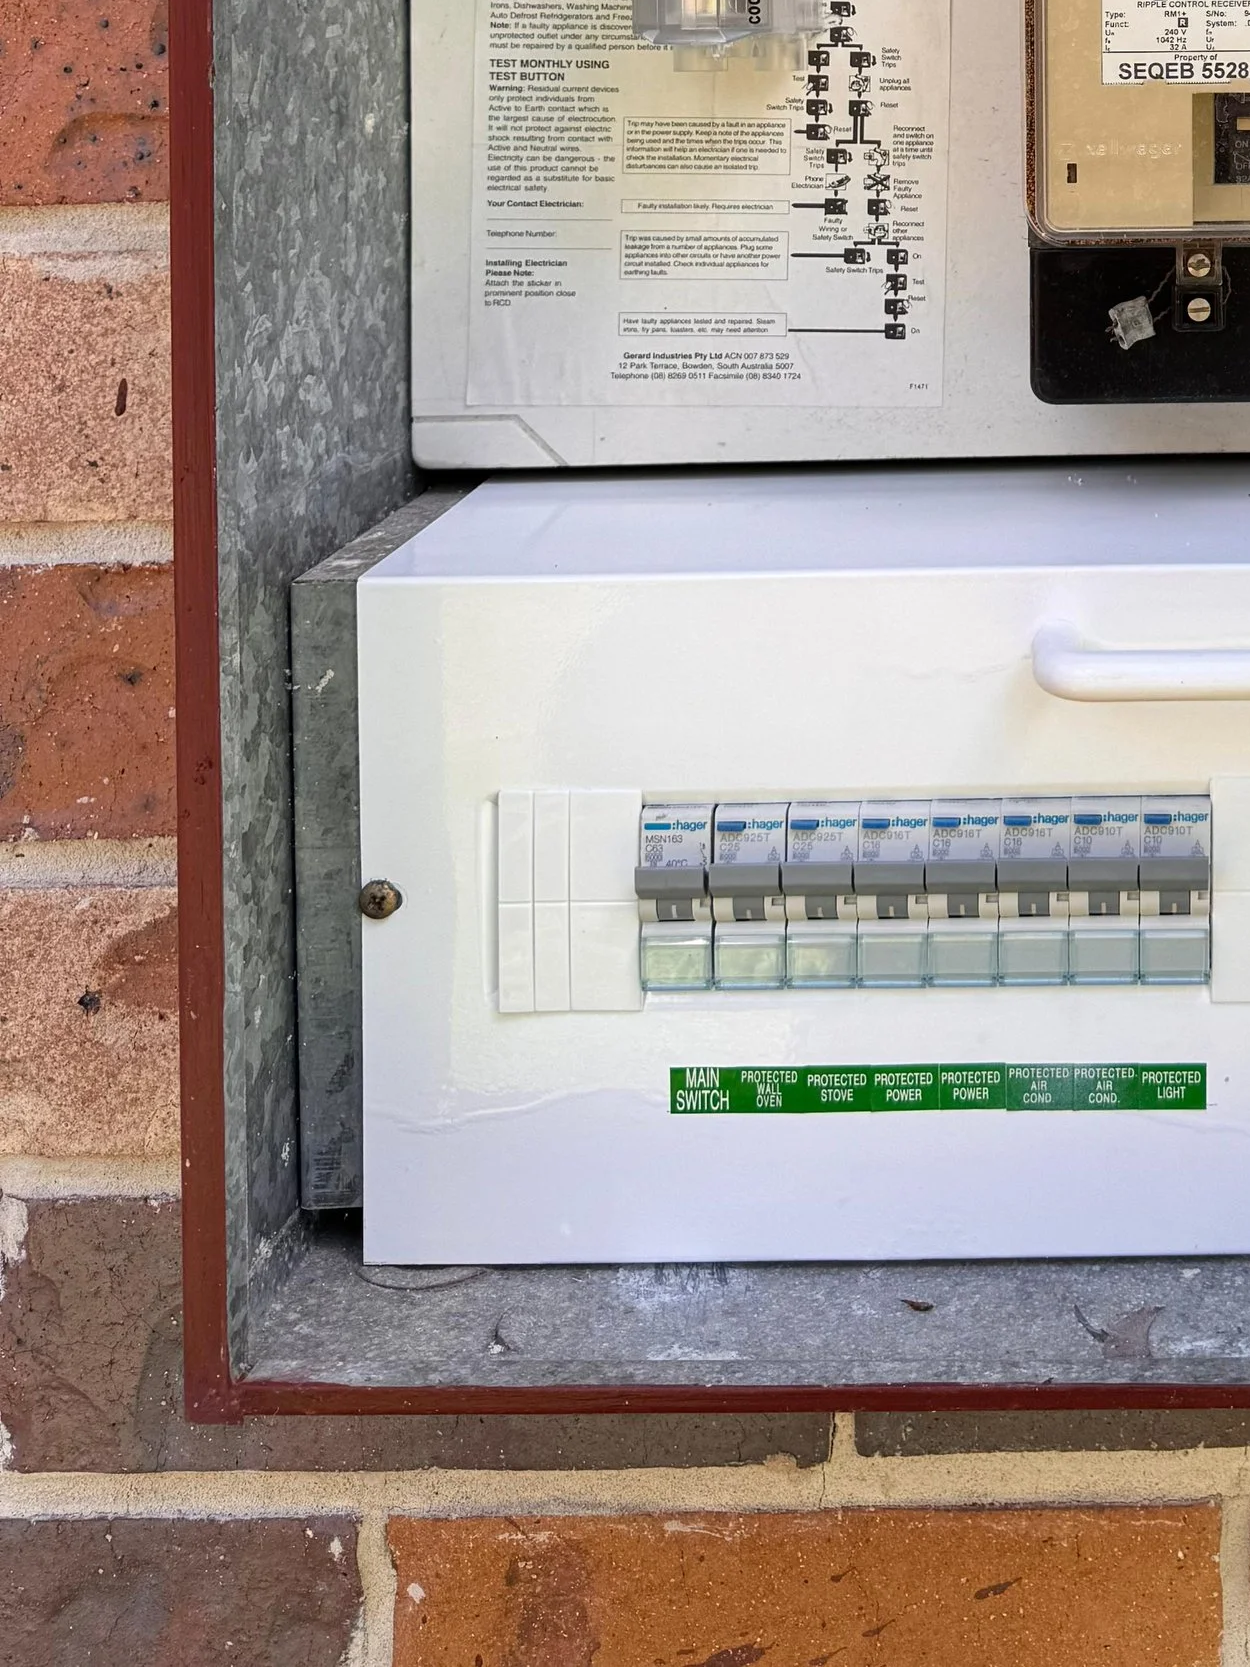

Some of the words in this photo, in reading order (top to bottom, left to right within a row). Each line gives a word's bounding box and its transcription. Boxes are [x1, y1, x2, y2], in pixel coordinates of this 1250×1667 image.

[490, 59, 517, 67] TEST
[521, 59, 572, 68] MONTHLY
[576, 60, 609, 69] USING
[489, 72, 517, 80] TEST
[520, 72, 564, 81] BUTTON
[1119, 63, 1194, 79] SEQEB
[646, 835, 682, 843] MSN163
[686, 1068, 719, 1087] MAIN
[741, 1071, 797, 1083] PROTECTED
[875, 1073, 933, 1085] PROTECTED
[942, 1071, 1001, 1083] PROTECTED
[1009, 1068, 1069, 1079] PROTECTED
[1074, 1068, 1134, 1079] PROTECTED
[1142, 1072, 1201, 1083] PROTECTED
[807, 1074, 867, 1086] PROTECTED
[1031, 1081, 1047, 1090] AIR
[1096, 1081, 1112, 1090] AIR
[755, 1080, 781, 1094] WALL
[1158, 1086, 1185, 1098] LIGHT
[821, 1089, 853, 1101] STOVE
[887, 1089, 922, 1101] POWER
[954, 1087, 988, 1100] POWER
[1089, 1093, 1120, 1103] COND.
[677, 1090, 729, 1110] SWITCH
[757, 1095, 782, 1107] OVEN
